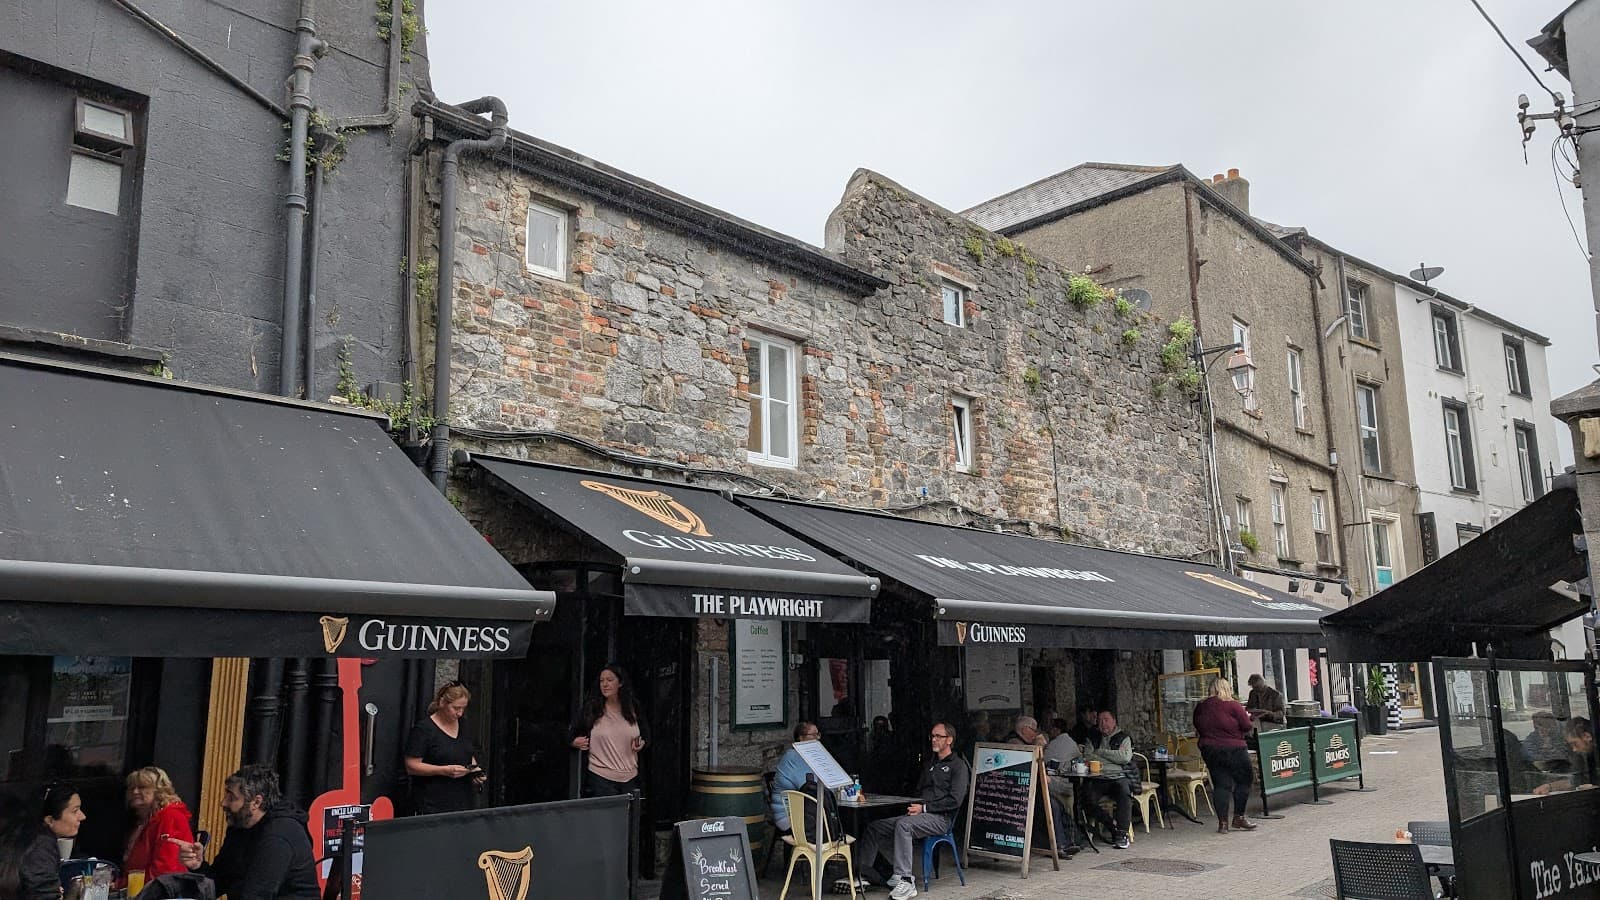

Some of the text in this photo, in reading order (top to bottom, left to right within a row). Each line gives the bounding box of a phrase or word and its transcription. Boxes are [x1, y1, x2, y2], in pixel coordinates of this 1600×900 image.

[622, 529, 817, 562] GUINNESS
[692, 593, 823, 617] THE PLAYWRIGHT
[358, 619, 510, 652] GUINNESS
[970, 622, 1026, 643] GUINNESS
[1194, 634, 1248, 647] THE PLAYWRIGHT
[1271, 756, 1300, 773] BULMERS
[1325, 748, 1350, 763] BULMERS
[699, 857, 737, 875] Breakfast
[700, 878, 729, 894] Served
[1530, 860, 1561, 899] The
